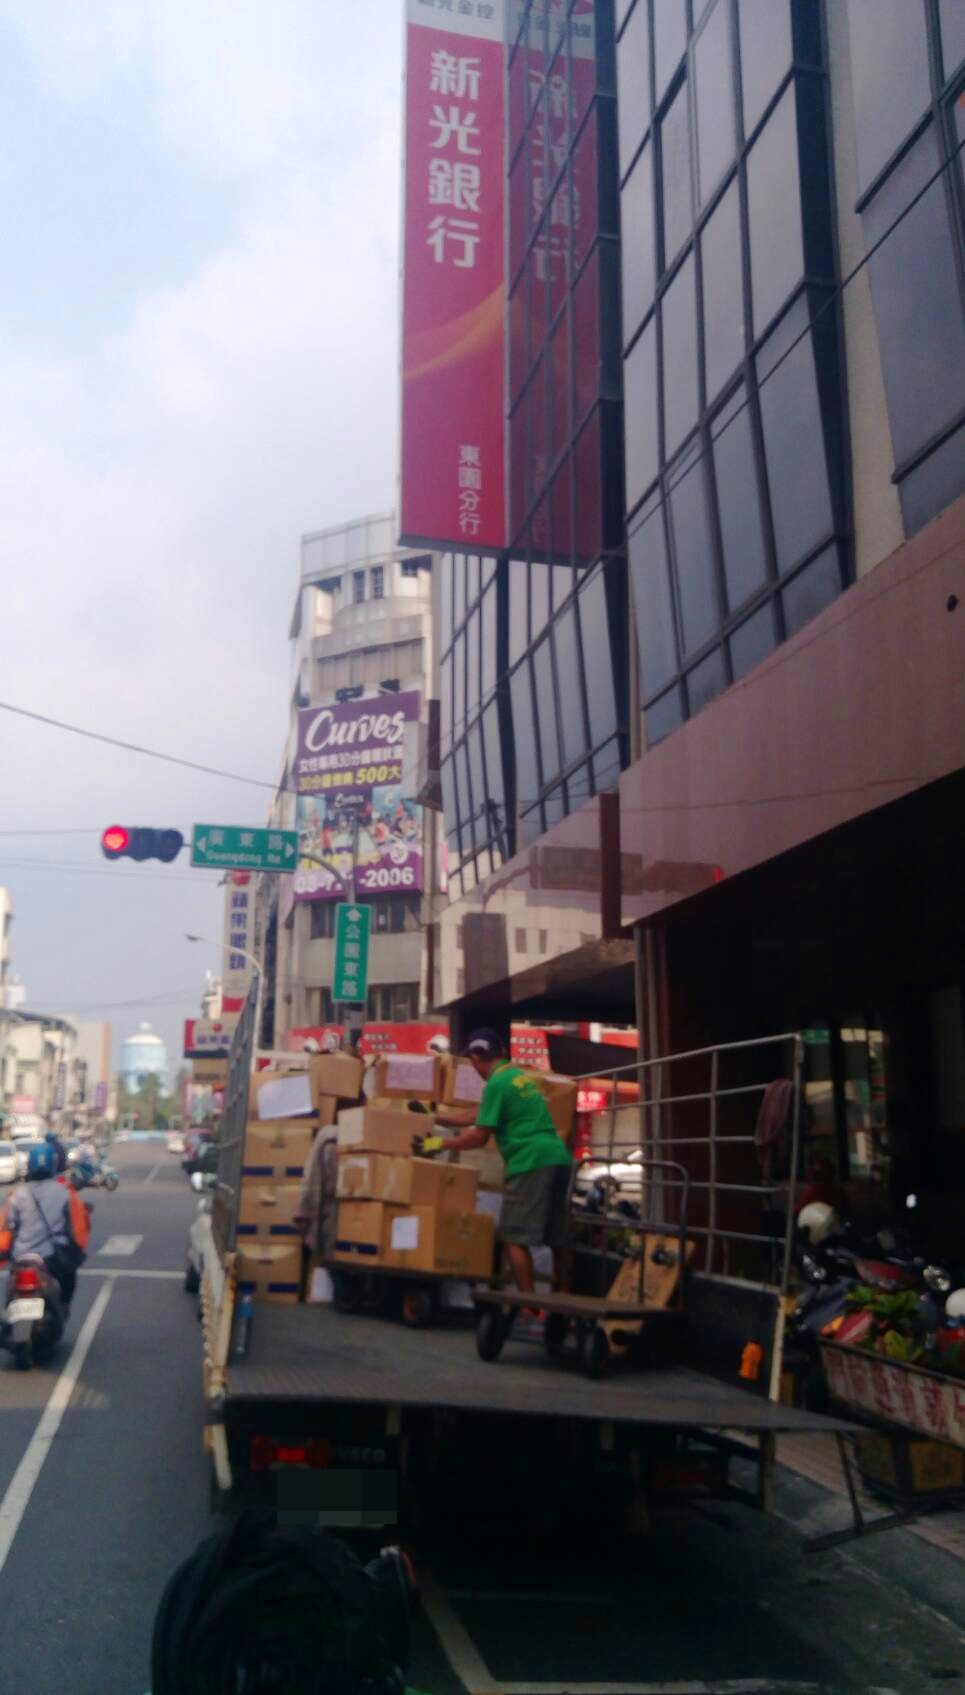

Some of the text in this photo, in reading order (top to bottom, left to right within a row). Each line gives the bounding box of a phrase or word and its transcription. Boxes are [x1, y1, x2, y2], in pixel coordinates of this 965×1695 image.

[426, 49, 482, 269] 新光銀行
[458, 444, 481, 537] 東園分行
[305, 709, 406, 752] Curves
[208, 829, 283, 849] 廣東路
[342, 923, 361, 997] 公園東路
